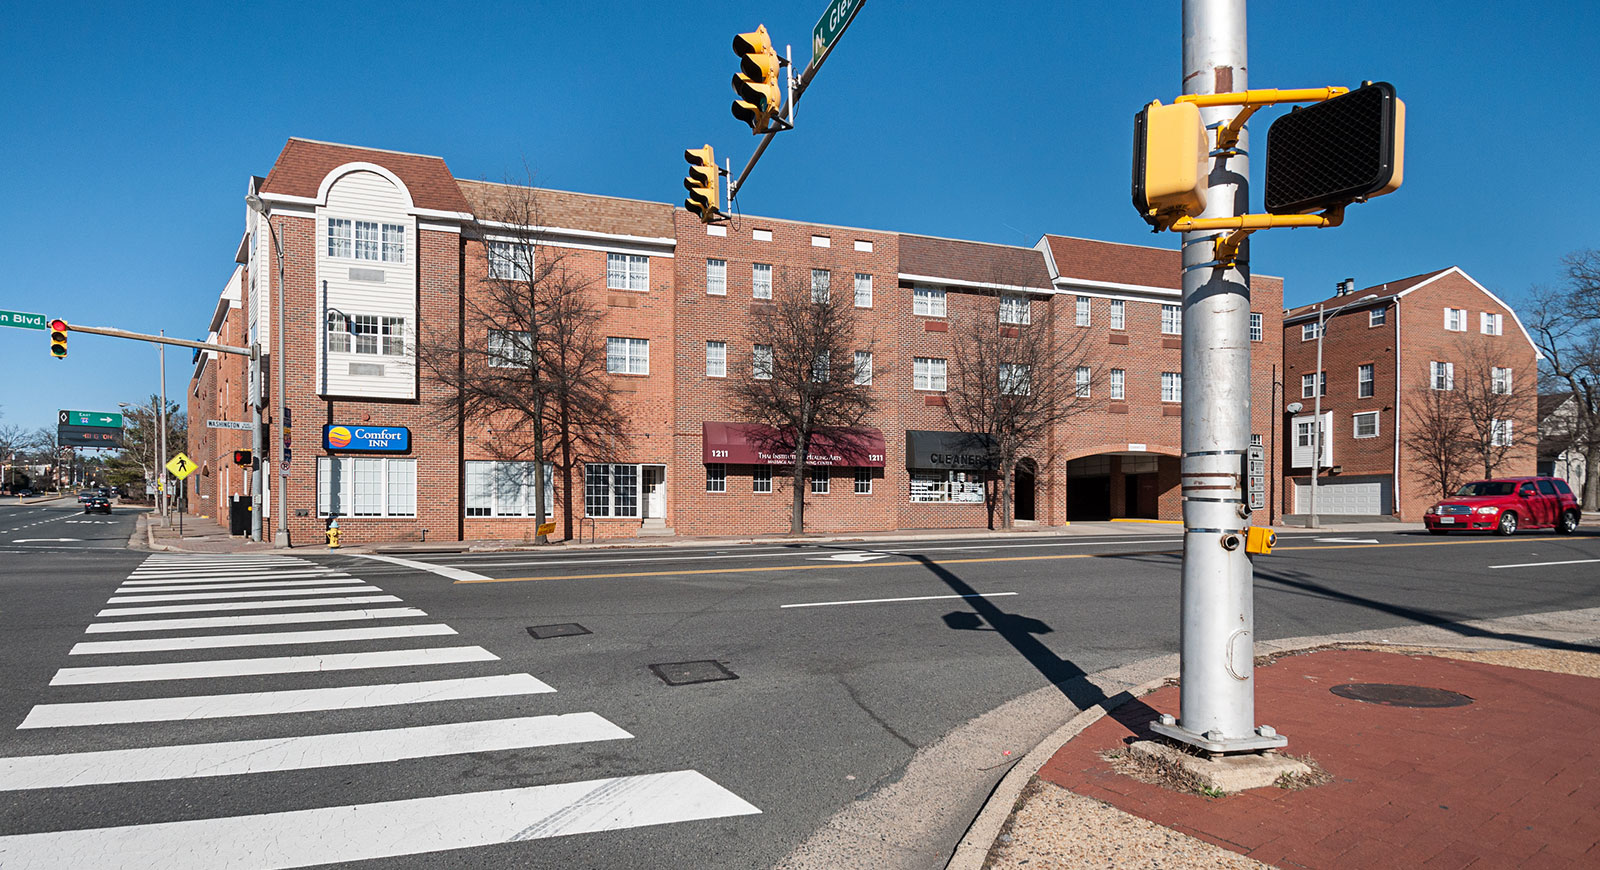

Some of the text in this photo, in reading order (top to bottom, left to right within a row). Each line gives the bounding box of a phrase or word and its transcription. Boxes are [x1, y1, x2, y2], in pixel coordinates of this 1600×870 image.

[815, 27, 826, 54] N.
[13, 314, 44, 326] Blvd.
[208, 420, 240, 429] WASHINGTON
[355, 429, 401, 440] Comfort
[711, 449, 729, 458] 1211
[868, 454, 884, 462] 1211
